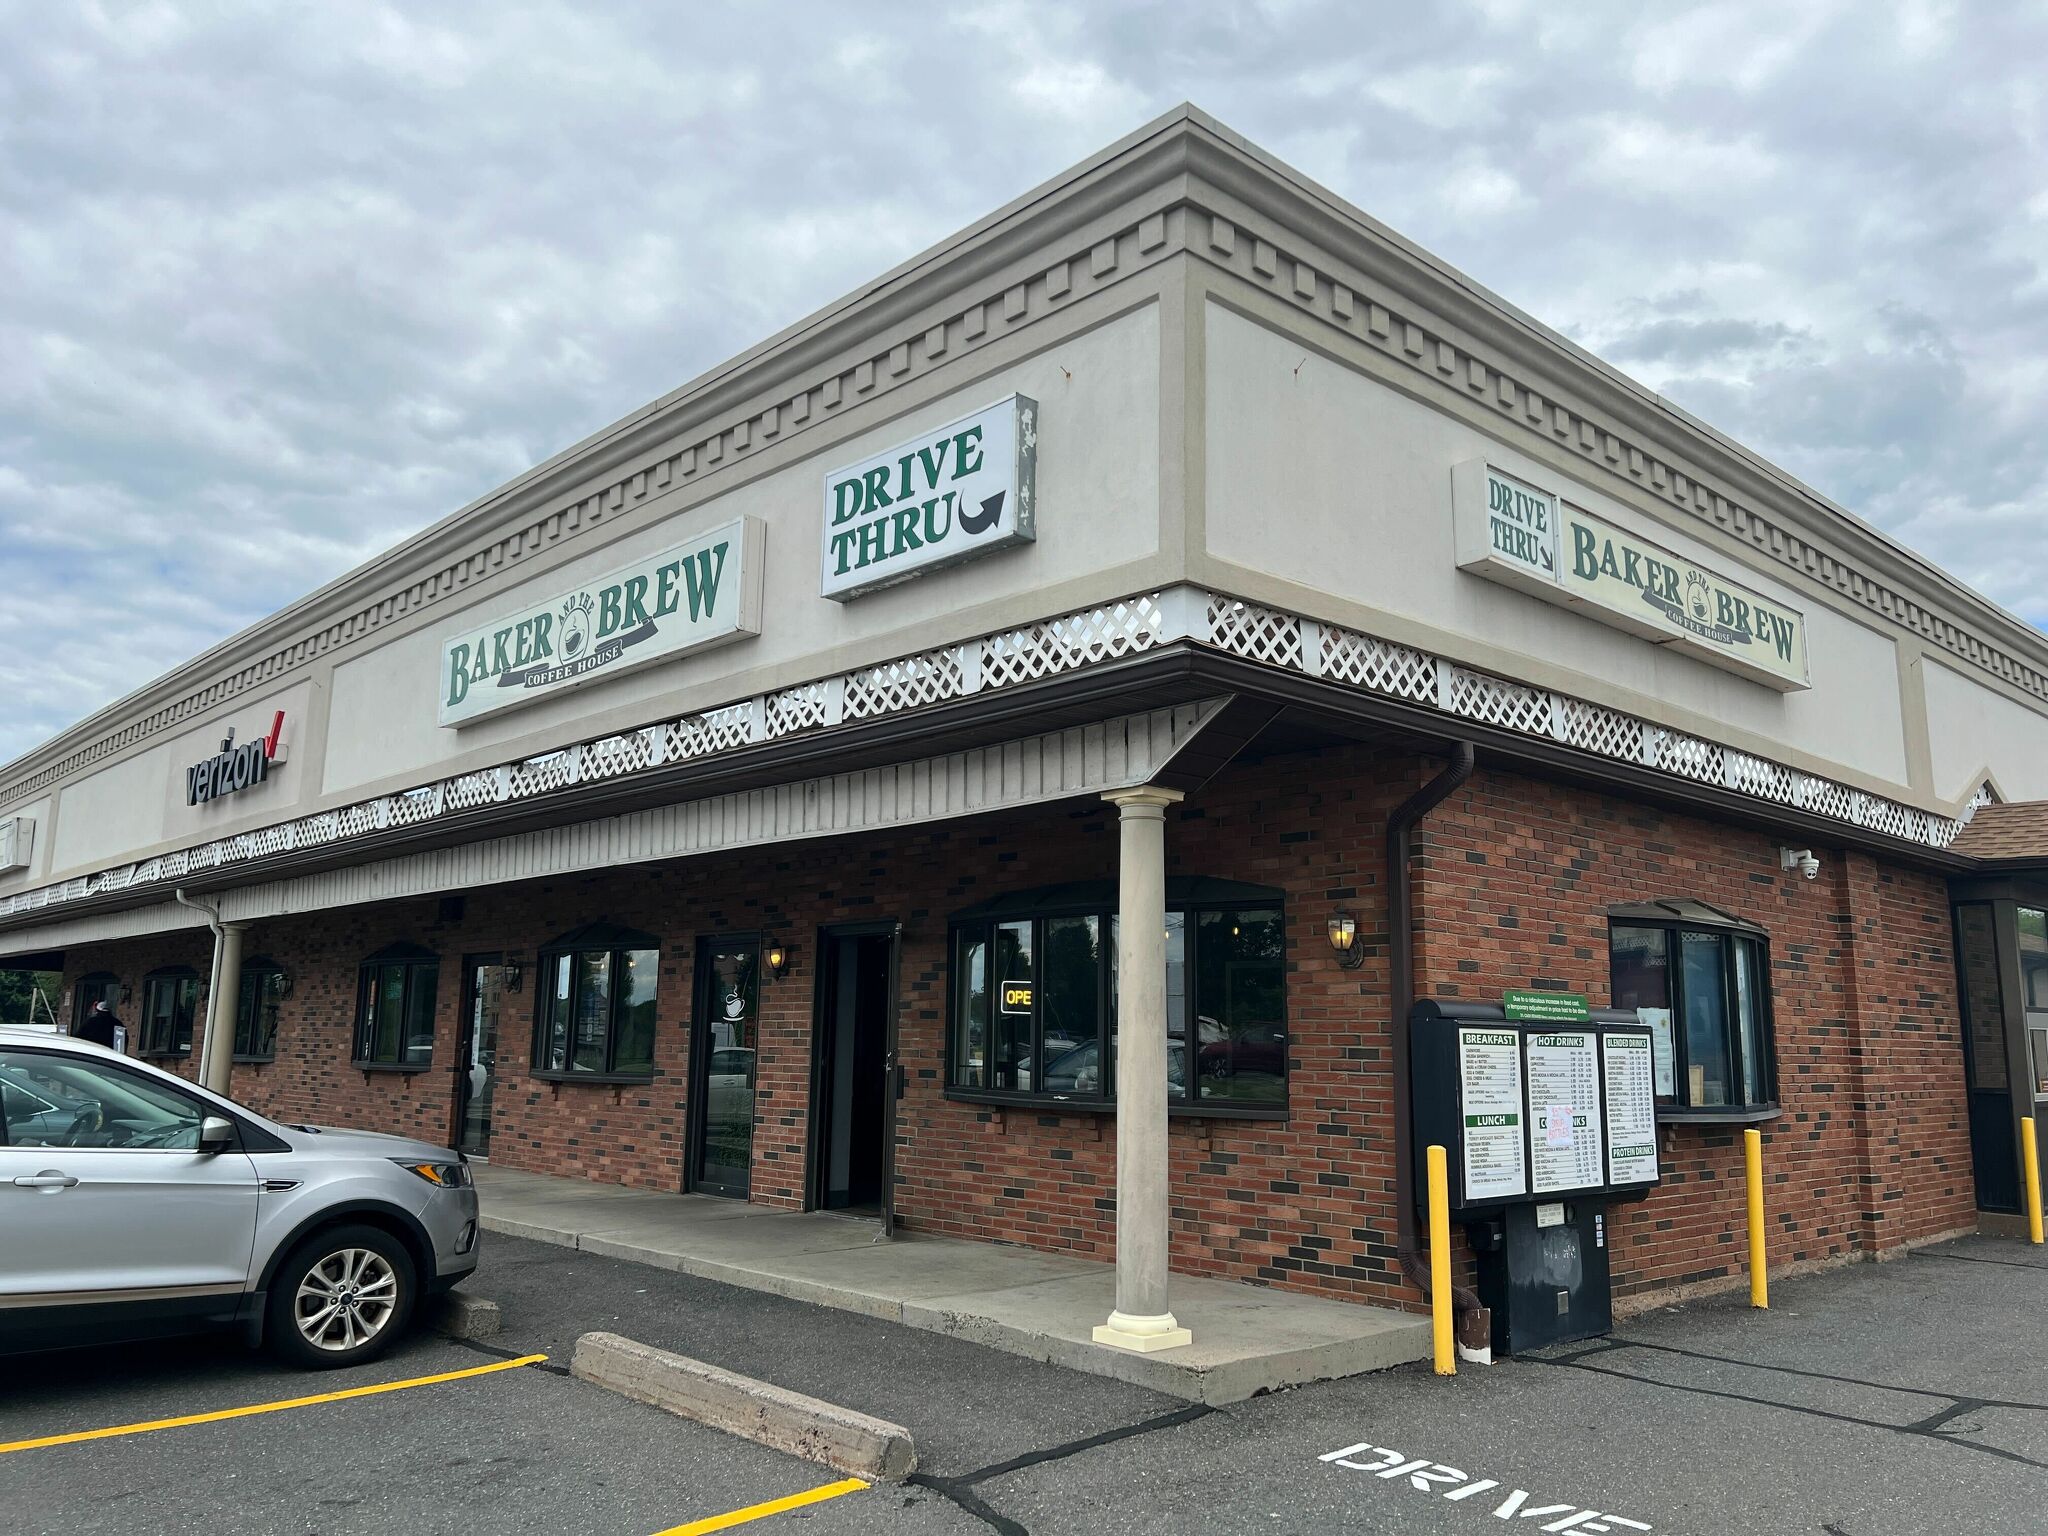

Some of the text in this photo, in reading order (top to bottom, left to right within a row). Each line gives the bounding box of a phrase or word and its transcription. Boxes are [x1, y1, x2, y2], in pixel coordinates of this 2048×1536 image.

[831, 424, 984, 527] DRIVE
[1489, 478, 1546, 534] DRIVE
[830, 490, 957, 577] THRU
[1491, 516, 1539, 565] THRU
[1570, 521, 1794, 663] BAKER BREW
[1698, 573, 1710, 594] THE
[447, 541, 729, 707] BAKER BREW
[558, 592, 594, 626] AND THE
[1667, 609, 1732, 643] COFFEE HOUSE
[527, 646, 620, 686] COFFEE HOUSE
[186, 727, 268, 806] verizon
[1006, 990, 1032, 1005] OPE
[1465, 1034, 1512, 1044] BREAKFAST
[1538, 1036, 1583, 1047] HOT DRINKS
[1607, 1038, 1646, 1048] BLENDED DRINKS
[1477, 1115, 1506, 1126] LUNCH
[1613, 1145, 1653, 1157] PROTEIN DRINKS
[1317, 1442, 1653, 1536] DRIVE
